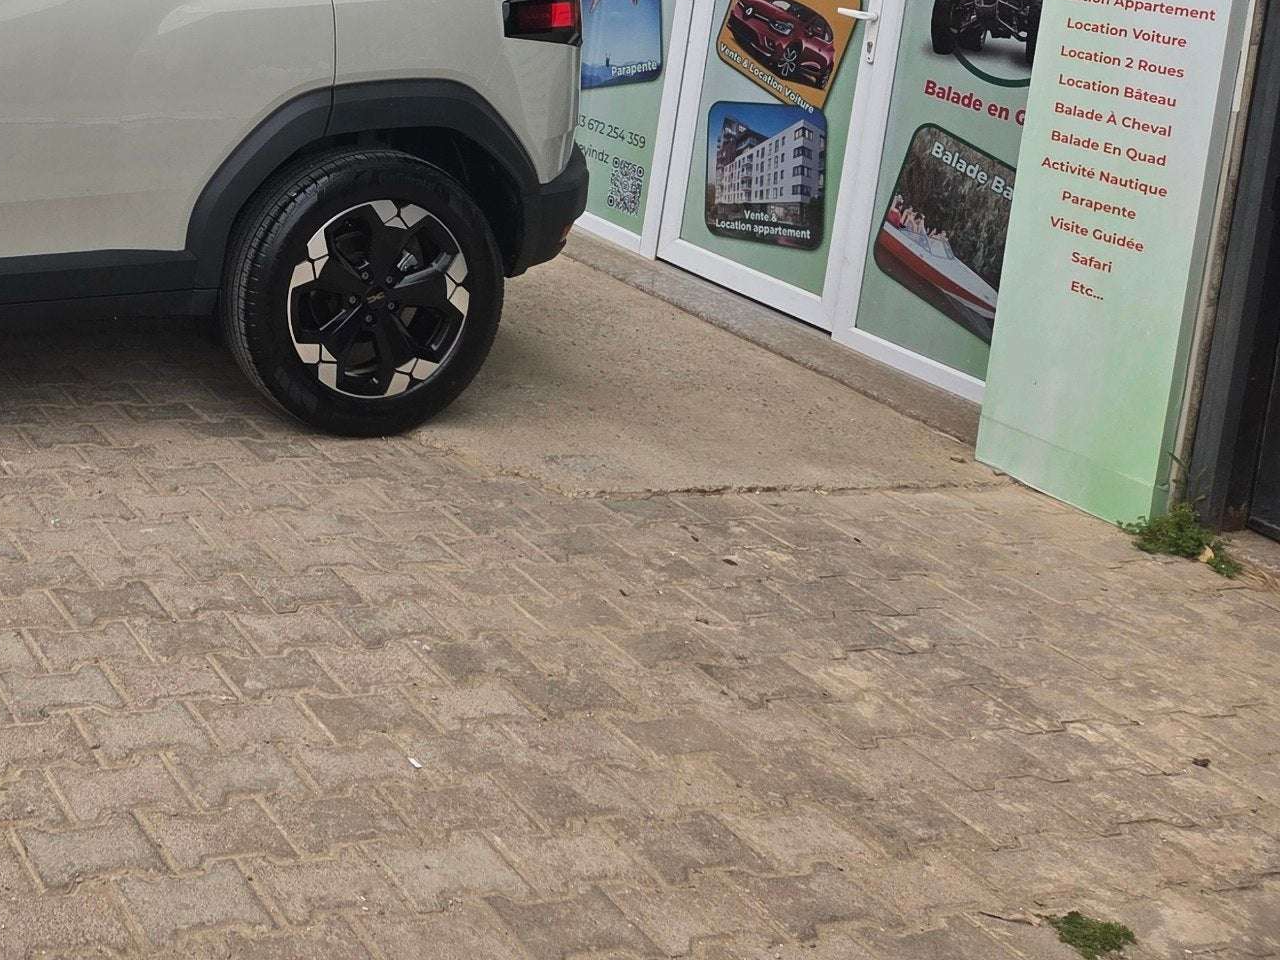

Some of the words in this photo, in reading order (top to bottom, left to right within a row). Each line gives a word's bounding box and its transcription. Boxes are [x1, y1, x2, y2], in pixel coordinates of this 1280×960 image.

[1067, 18, 1128, 38] Location
[1132, 28, 1187, 48] Voiture
[611, 60, 658, 77] Parapente
[1061, 45, 1121, 66] Location
[1124, 57, 1134, 69] 2
[1138, 59, 1185, 78] Roues
[720, 43, 742, 64] Vente
[742, 59, 750, 68] &
[750, 63, 783, 92] Location
[785, 87, 814, 114] Voiture
[1058, 74, 1120, 96] Location
[1124, 86, 1177, 107] Bâteau
[924, 80, 983, 111] Balade
[988, 103, 1009, 120] en
[588, 118, 606, 135] 672
[606, 125, 625, 142] 254
[627, 131, 646, 149] 359
[1055, 102, 1103, 122] Balade
[1106, 110, 1117, 125] À
[1122, 116, 1172, 137] Cheval
[931, 141, 988, 184] Balade
[1051, 130, 1100, 151] Balade
[1103, 142, 1121, 156] En
[1126, 147, 1167, 166] Quad
[1041, 157, 1095, 179] Activité
[1099, 171, 1168, 197] Nautique
[744, 210, 769, 221] Vente
[770, 213, 777, 222] &
[1062, 191, 1137, 219] Parapente
[715, 218, 751, 231] Location
[753, 224, 811, 239] appartement
[1050, 216, 1089, 236] Visite
[1092, 229, 1144, 252] Guidée
[1071, 252, 1112, 273] Safari
[1070, 281, 1104, 301] Etc...
